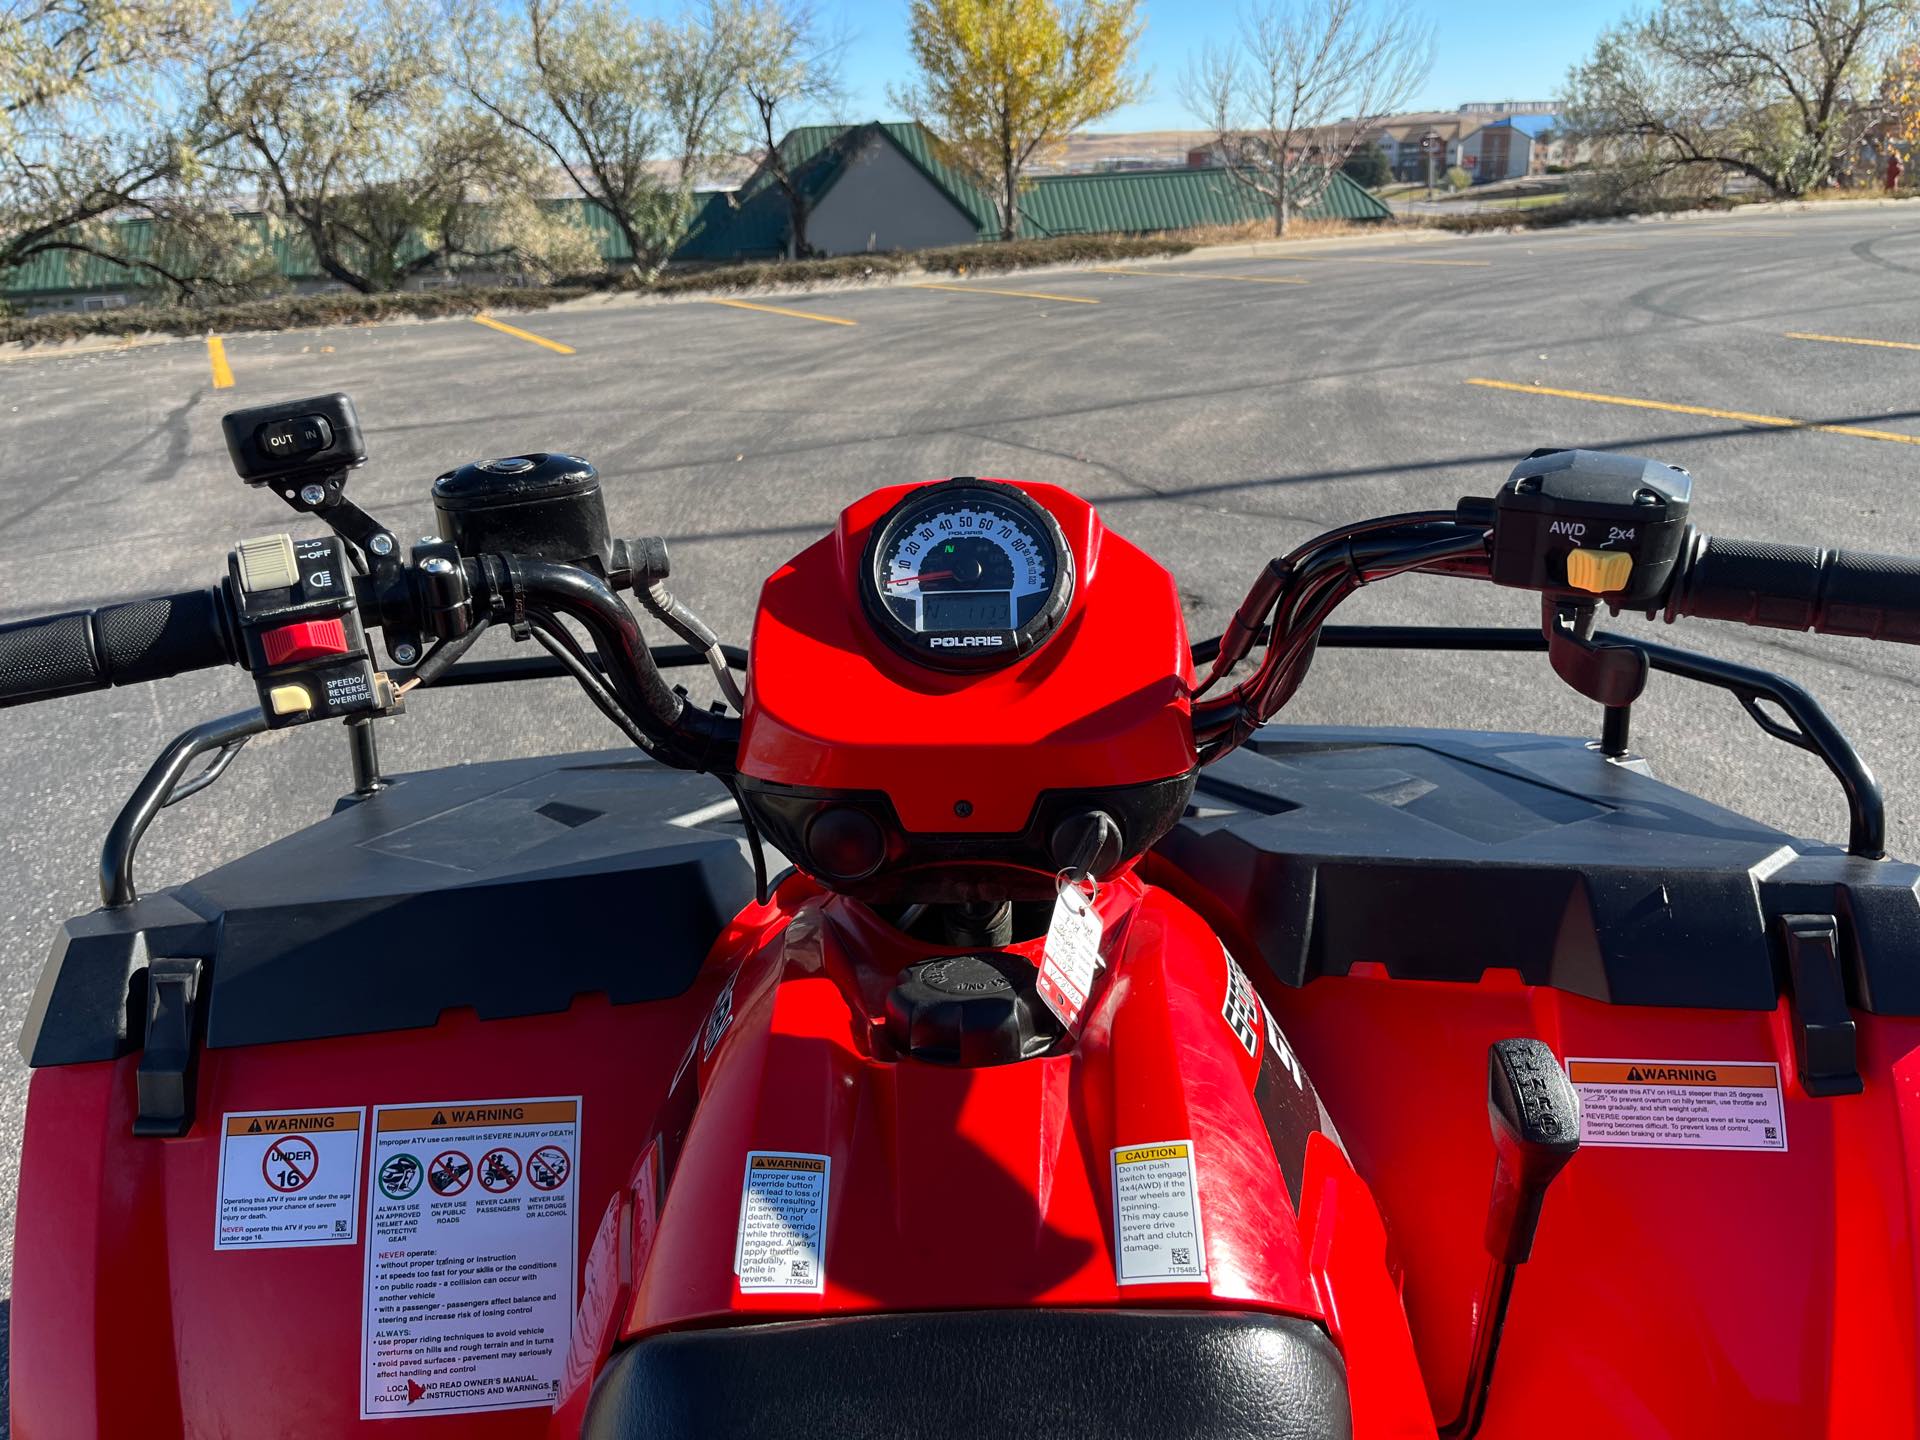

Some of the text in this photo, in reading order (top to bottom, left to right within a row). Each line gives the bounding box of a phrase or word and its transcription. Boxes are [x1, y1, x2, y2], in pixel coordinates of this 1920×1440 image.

[270, 430, 317, 446] OUT IN
[1550, 521, 1635, 539] AWD 2x4
[899, 560, 910, 569] 10
[906, 543, 920, 554] 20
[920, 528, 934, 541] 30
[939, 519, 953, 531] 40
[959, 517, 972, 527] 50
[979, 518, 993, 530] 60
[998, 526, 1012, 539] 70
[1012, 539, 1025, 552] 80
[308, 550, 331, 559] OFF
[930, 636, 1002, 647] POLARIS
[327, 674, 365, 688] SPEEDO/
[328, 684, 367, 695] REVERSE
[328, 692, 371, 705] OVERRIDE
[1642, 1069, 1717, 1081] WARNING
[452, 1108, 524, 1122] WARNING
[266, 1117, 334, 1130] WARNING
[379, 1138, 410, 1147] Improper
[513, 1131, 540, 1139] INJURY
[272, 1151, 312, 1162] UNDER
[1126, 1148, 1176, 1160] CAUTION
[768, 1159, 822, 1170] WARNING
[1119, 1161, 1169, 1173] Do not push
[277, 1170, 300, 1187] 16
[753, 1172, 789, 1181] Improper
[1120, 1172, 1186, 1182] switch to engage
[752, 1180, 813, 1189] override button
[1120, 1181, 1161, 1192] 4x4(AWD)
[1171, 1179, 1184, 1187] the
[224, 1197, 252, 1205] Operating
[750, 1196, 815, 1206] control resulting
[1139, 1191, 1169, 1200] wheels
[477, 1205, 520, 1213] PASSENGERS
[786, 1206, 808, 1214] injury
[1121, 1202, 1160, 1213] spinning.
[1121, 1213, 1139, 1221] This
[1142, 1213, 1160, 1222] may
[245, 1225, 269, 1233] operate
[781, 1222, 815, 1230] override
[1153, 1221, 1175, 1229] drive
[1123, 1231, 1192, 1241] shaft and clutch
[745, 1240, 815, 1248] engaged. Always
[1124, 1242, 1162, 1253] damage.
[379, 1249, 437, 1259] NEVER operate:
[744, 1248, 767, 1257] apply
[409, 1260, 434, 1268] proper
[435, 1257, 464, 1267] training
[476, 1254, 516, 1263] instruction
[743, 1257, 786, 1265] gradually,
[439, 1380, 462, 1388] READ
[462, 1377, 500, 1386] OWNER'S
[502, 1374, 538, 1383] MANUAL.
[374, 1393, 407, 1402] FOLLOW
[426, 1387, 485, 1398] INSTRUCTIONS
[505, 1383, 551, 1392] WARNINGS.
